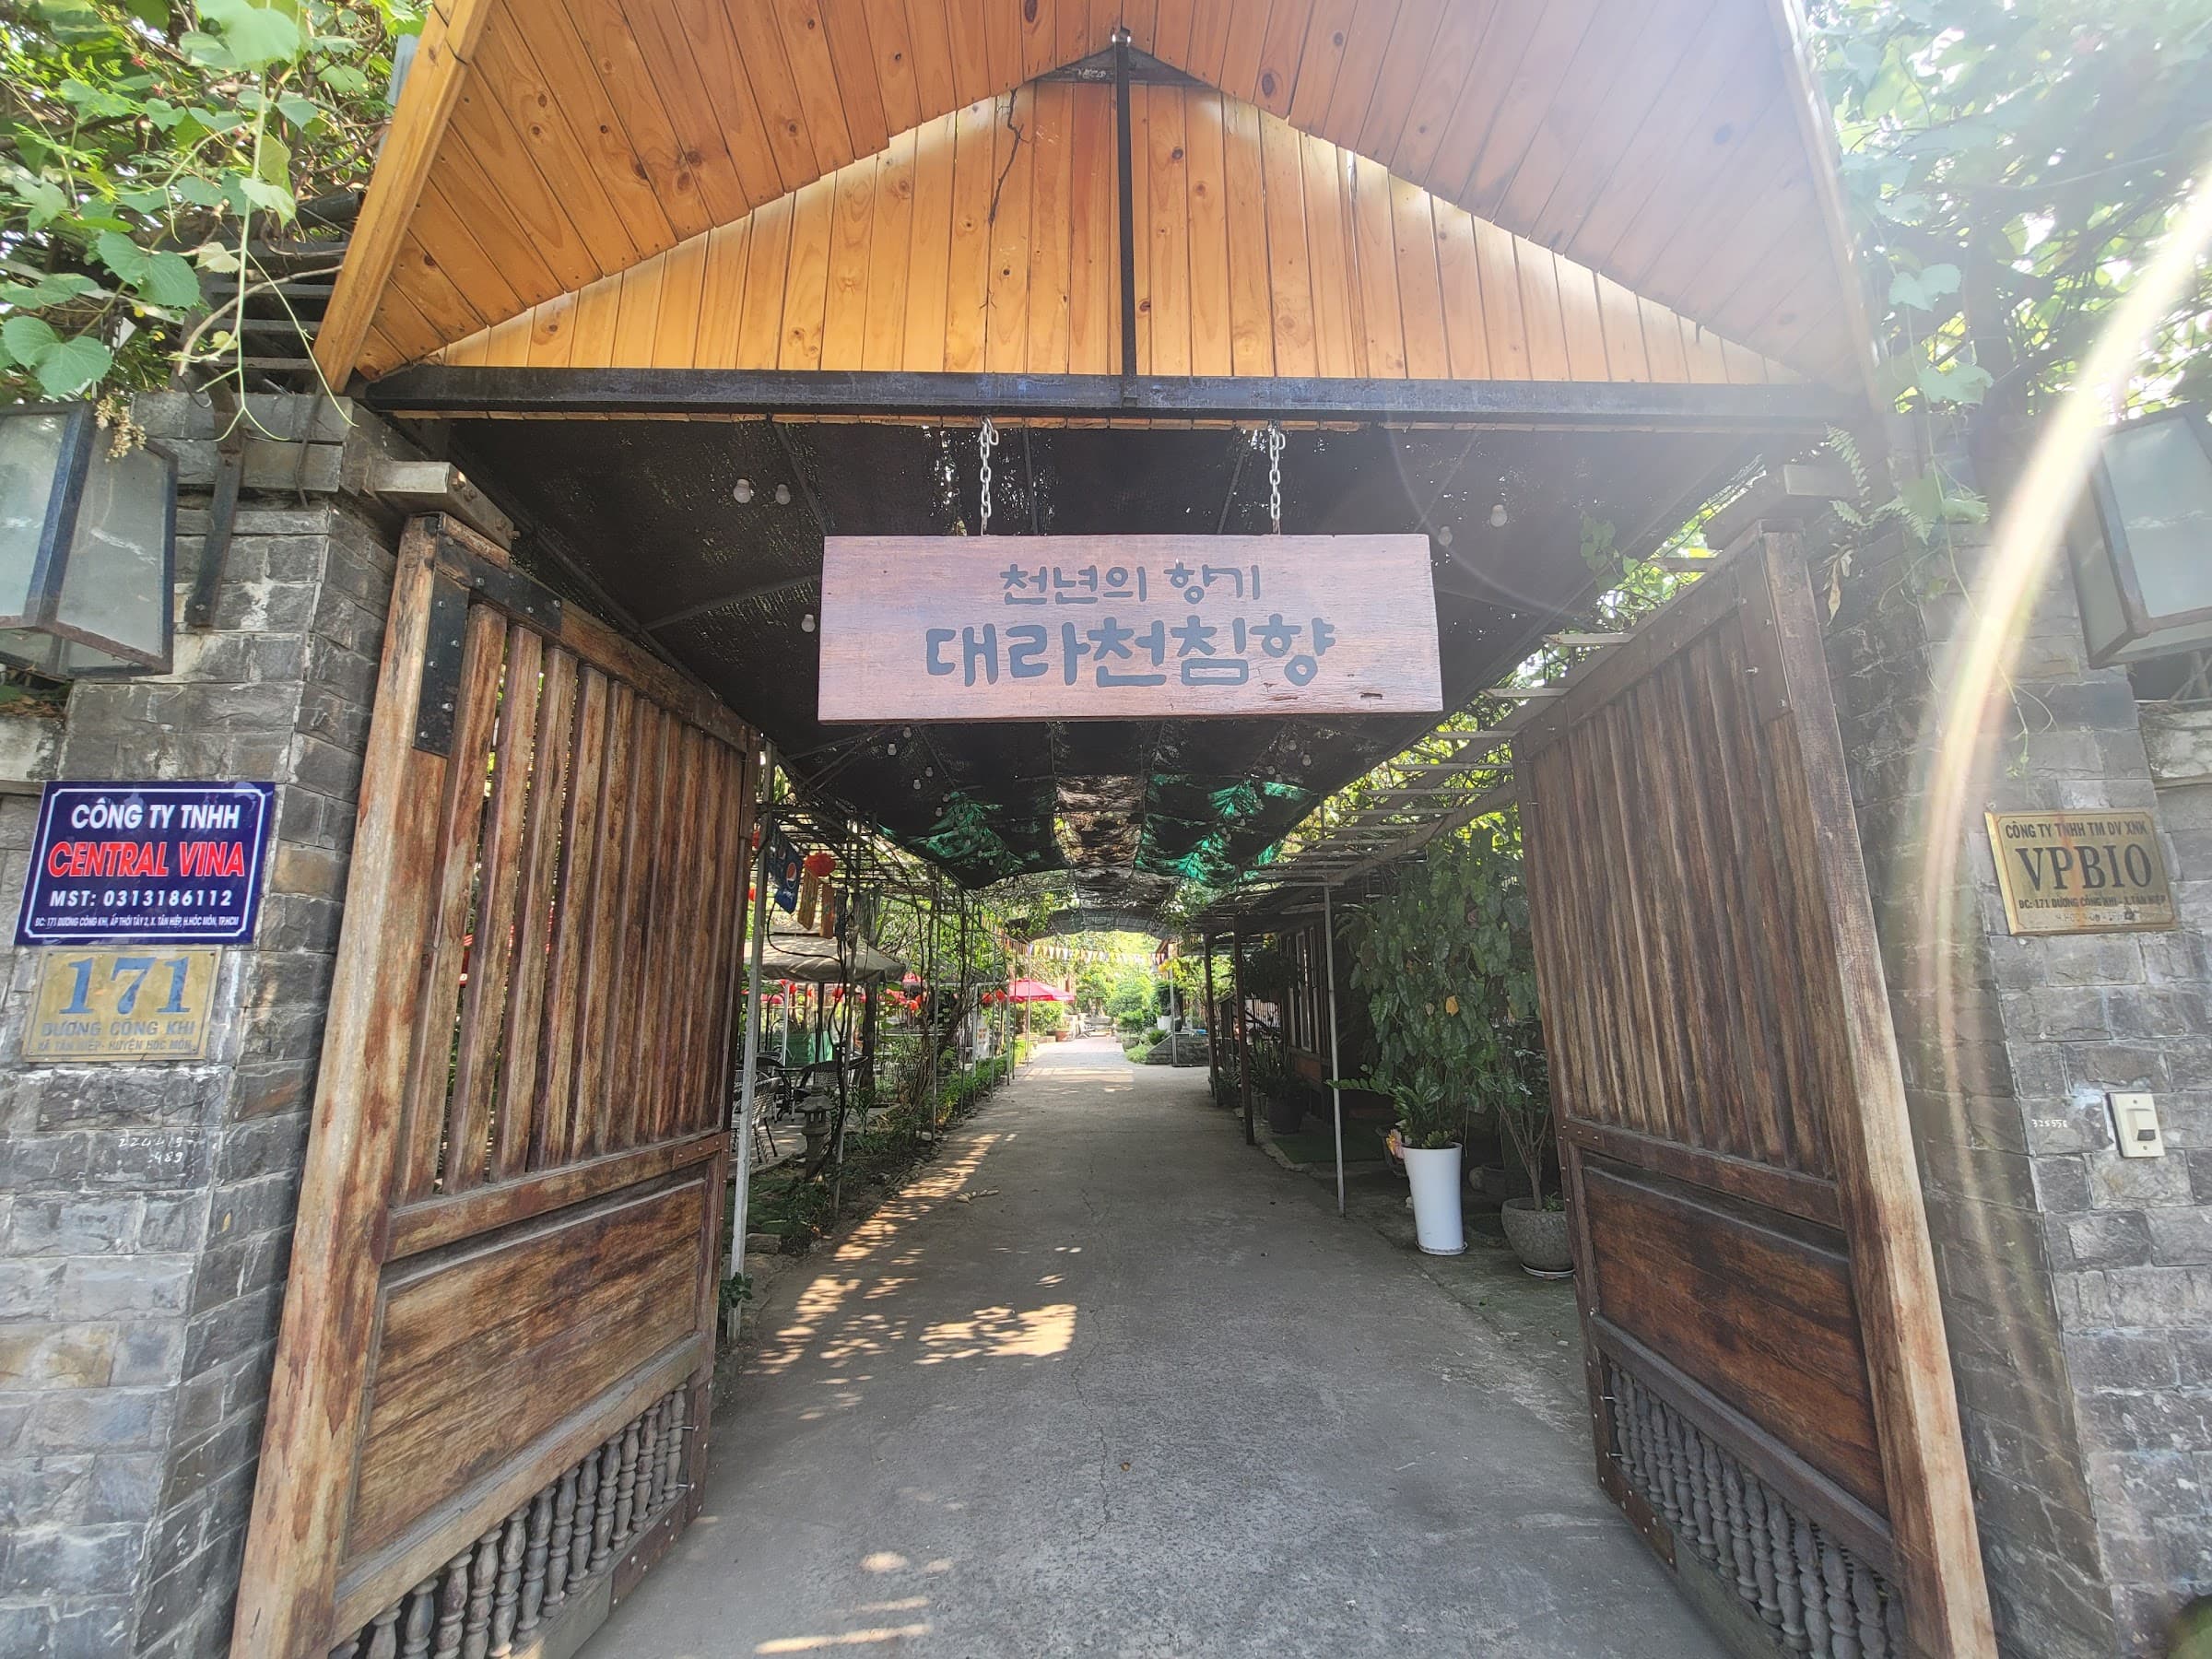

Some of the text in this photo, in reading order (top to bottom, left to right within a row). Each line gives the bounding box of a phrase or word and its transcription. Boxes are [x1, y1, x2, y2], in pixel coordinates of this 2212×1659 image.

[999, 560, 1261, 606] 천년의 향기
[925, 613, 1335, 687] 대라천침향
[71, 796, 241, 830] CÔNG TY TNHH
[2037, 823, 2053, 839] TY
[2053, 822, 2087, 839] TNHH
[2086, 821, 2106, 837] TM
[47, 841, 245, 877] CENTRAL VINA
[2015, 843, 2152, 891] VPBIO
[49, 889, 232, 907] MST: 0313186112
[59, 956, 191, 1015] 171
